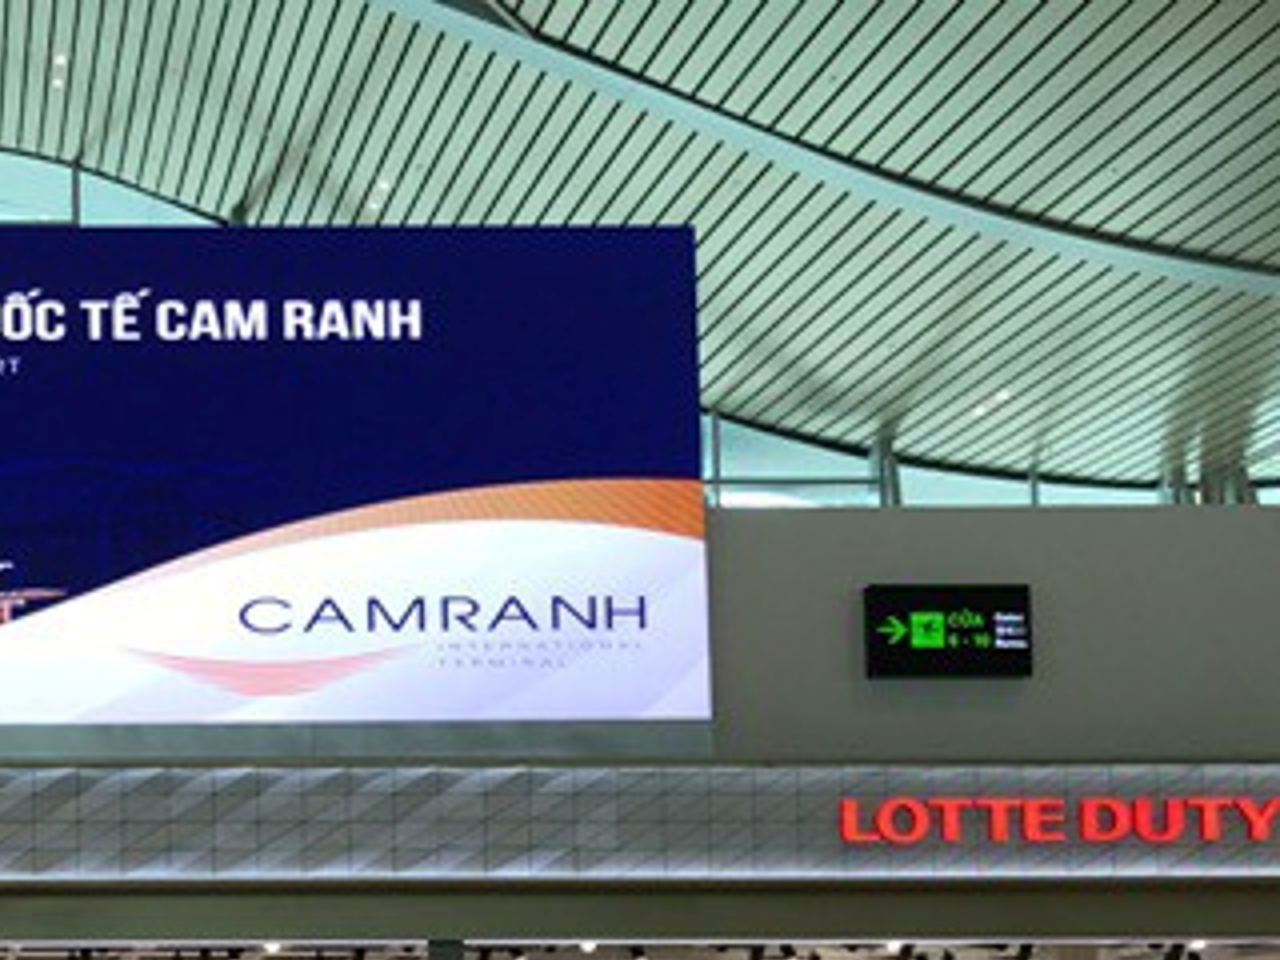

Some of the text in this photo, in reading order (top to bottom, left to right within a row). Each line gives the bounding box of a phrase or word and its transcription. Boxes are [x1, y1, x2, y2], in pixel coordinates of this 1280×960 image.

[79, 288, 151, 341] TẾ
[155, 299, 268, 341] CAM
[283, 299, 423, 341] RANH
[238, 594, 648, 634] CAMRANH
[840, 797, 1280, 844] LOTTE DUTY
